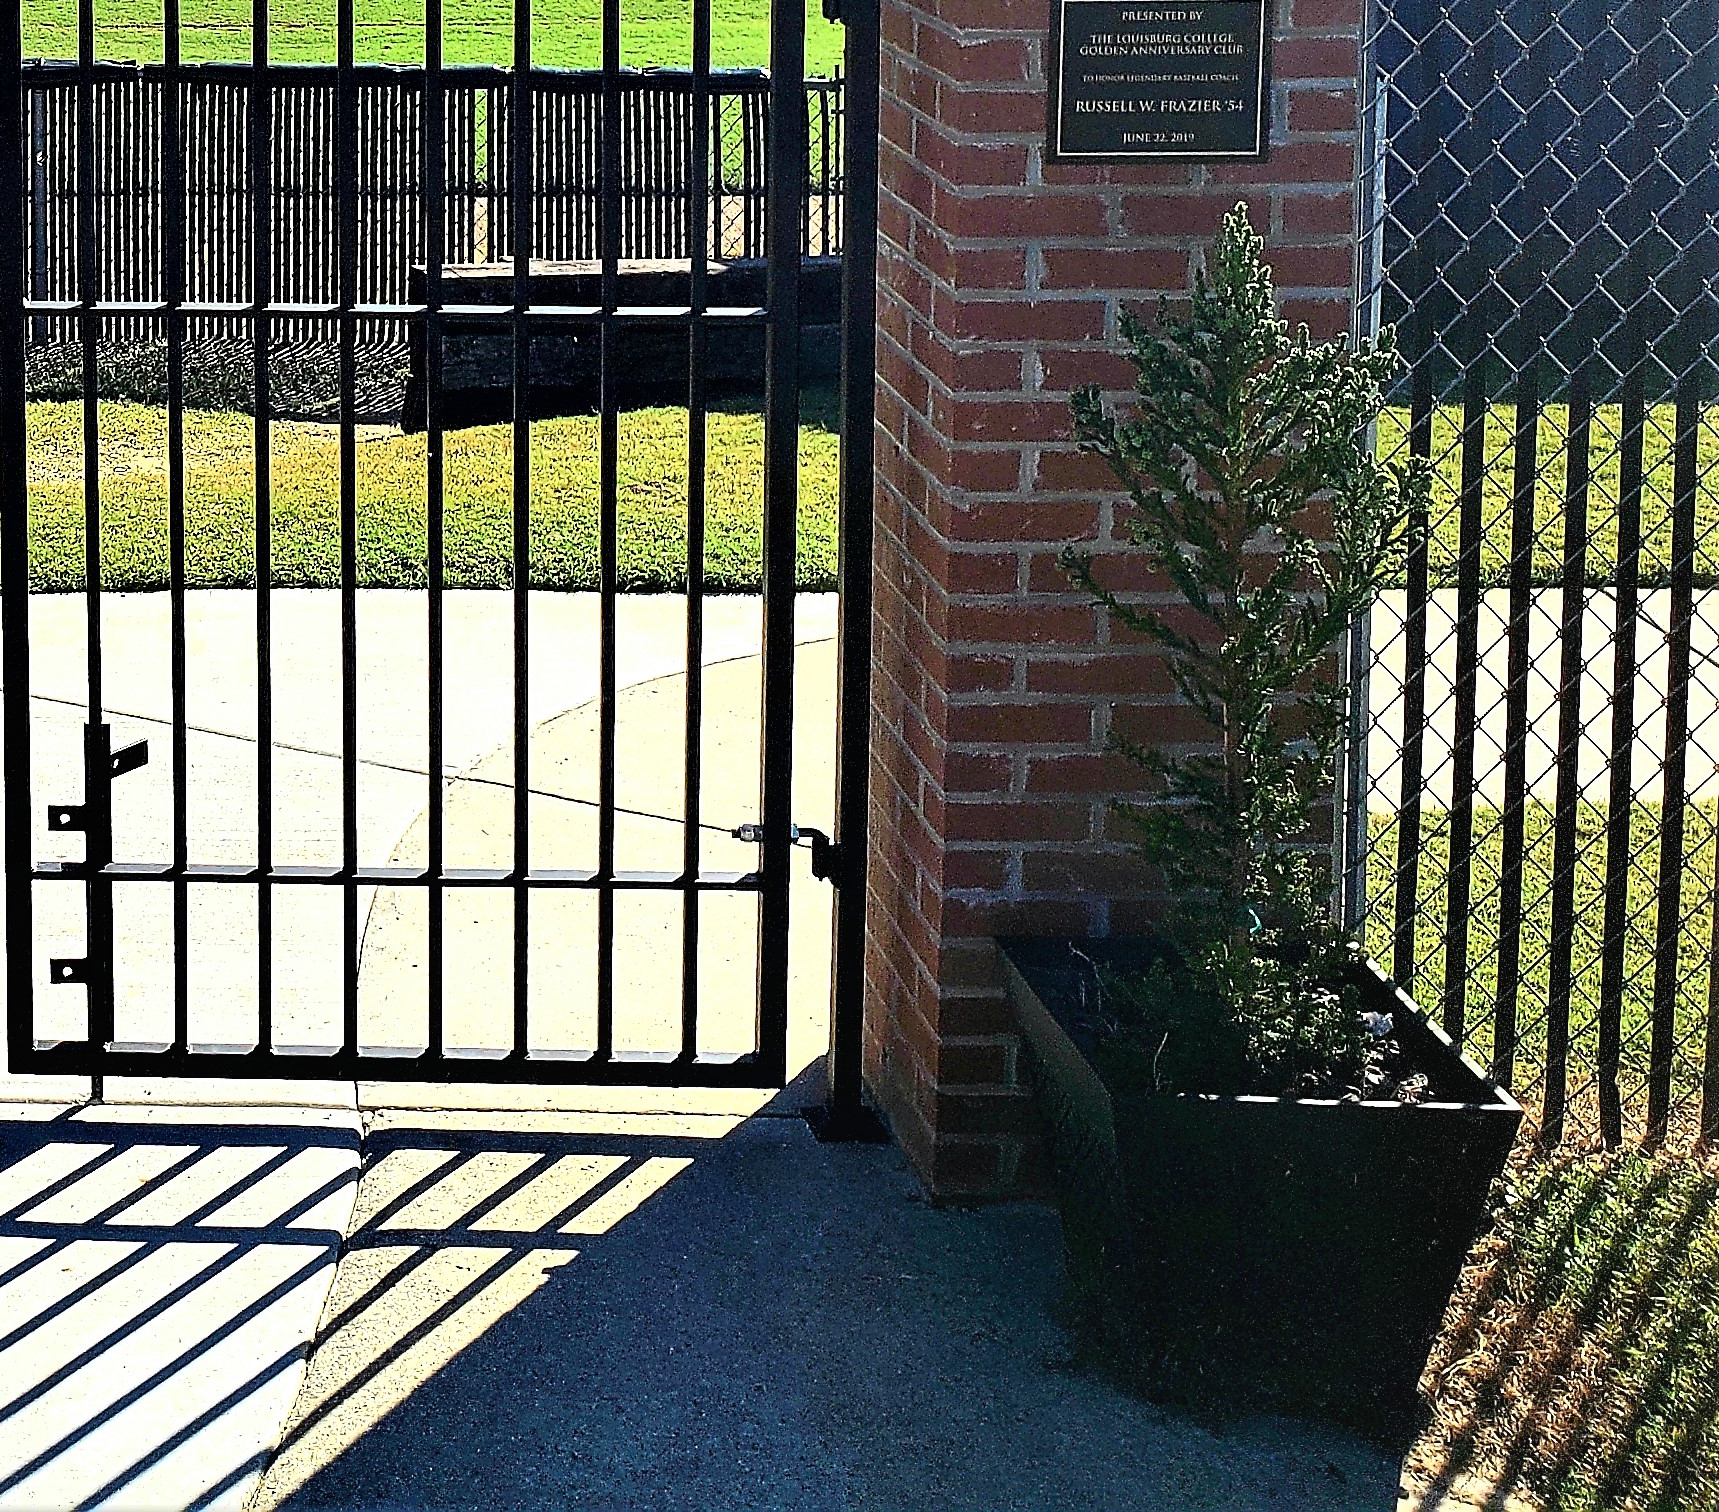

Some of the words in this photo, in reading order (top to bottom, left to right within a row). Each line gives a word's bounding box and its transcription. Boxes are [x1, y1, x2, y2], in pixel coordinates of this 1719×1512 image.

[1122, 10, 1187, 21] PRESENTED
[1189, 10, 1203, 20] BY
[1090, 34, 1114, 44] THE
[1117, 33, 1181, 44] LOUISBURG
[1183, 33, 1235, 43] COLLEGE
[1079, 45, 1128, 56] GOLDEN
[1131, 44, 1211, 55] ANNIVERSARY
[1213, 44, 1243, 55] CLUB
[1082, 73, 1094, 83] TO
[1076, 100, 1136, 113] RUSSELL
[1139, 100, 1156, 112] W.
[1160, 100, 1222, 112] FRAZIER
[1225, 99, 1244, 111] '54
[1122, 132, 1151, 144] JUNE
[1171, 132, 1195, 143] 2019
